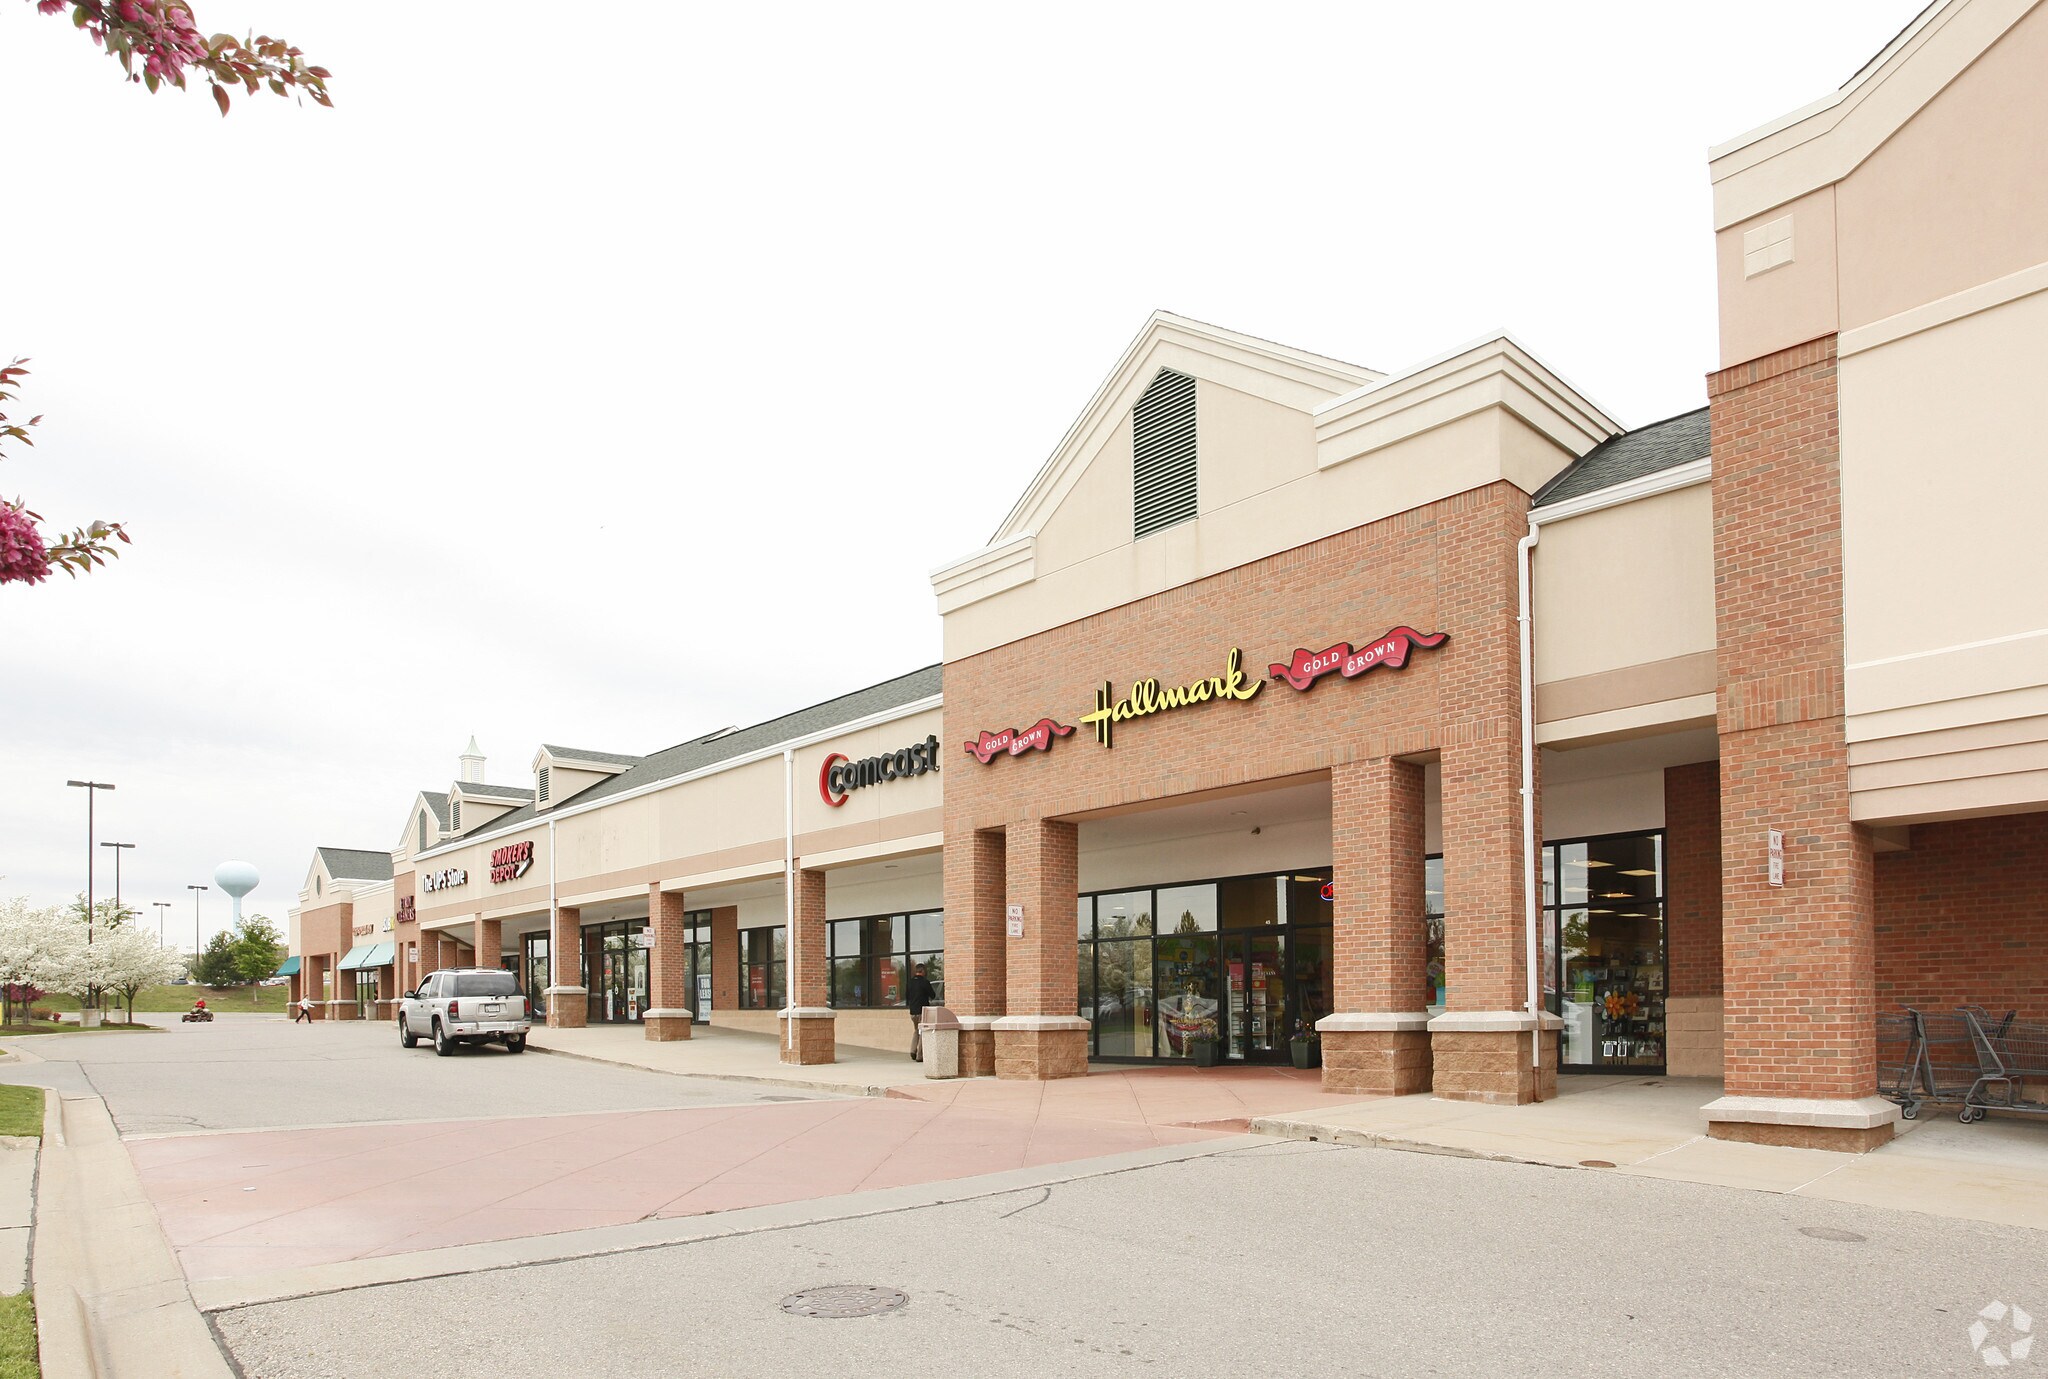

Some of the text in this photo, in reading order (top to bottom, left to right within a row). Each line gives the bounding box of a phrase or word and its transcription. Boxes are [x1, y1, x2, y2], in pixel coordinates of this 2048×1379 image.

[1302, 641, 1396, 674] GOLD CROWN
[1078, 647, 1267, 748] Hallmark
[985, 729, 1043, 752] GOLD CROWN
[1773, 836, 1778, 846] NO
[490, 841, 532, 868] SMOKER'S
[1770, 848, 1782, 860] PARKING
[422, 867, 467, 893] The UPS Store
[490, 865, 515, 884] DEPOT
[1320, 884, 1333, 896] OP
[1008, 915, 1023, 923] PARKING
